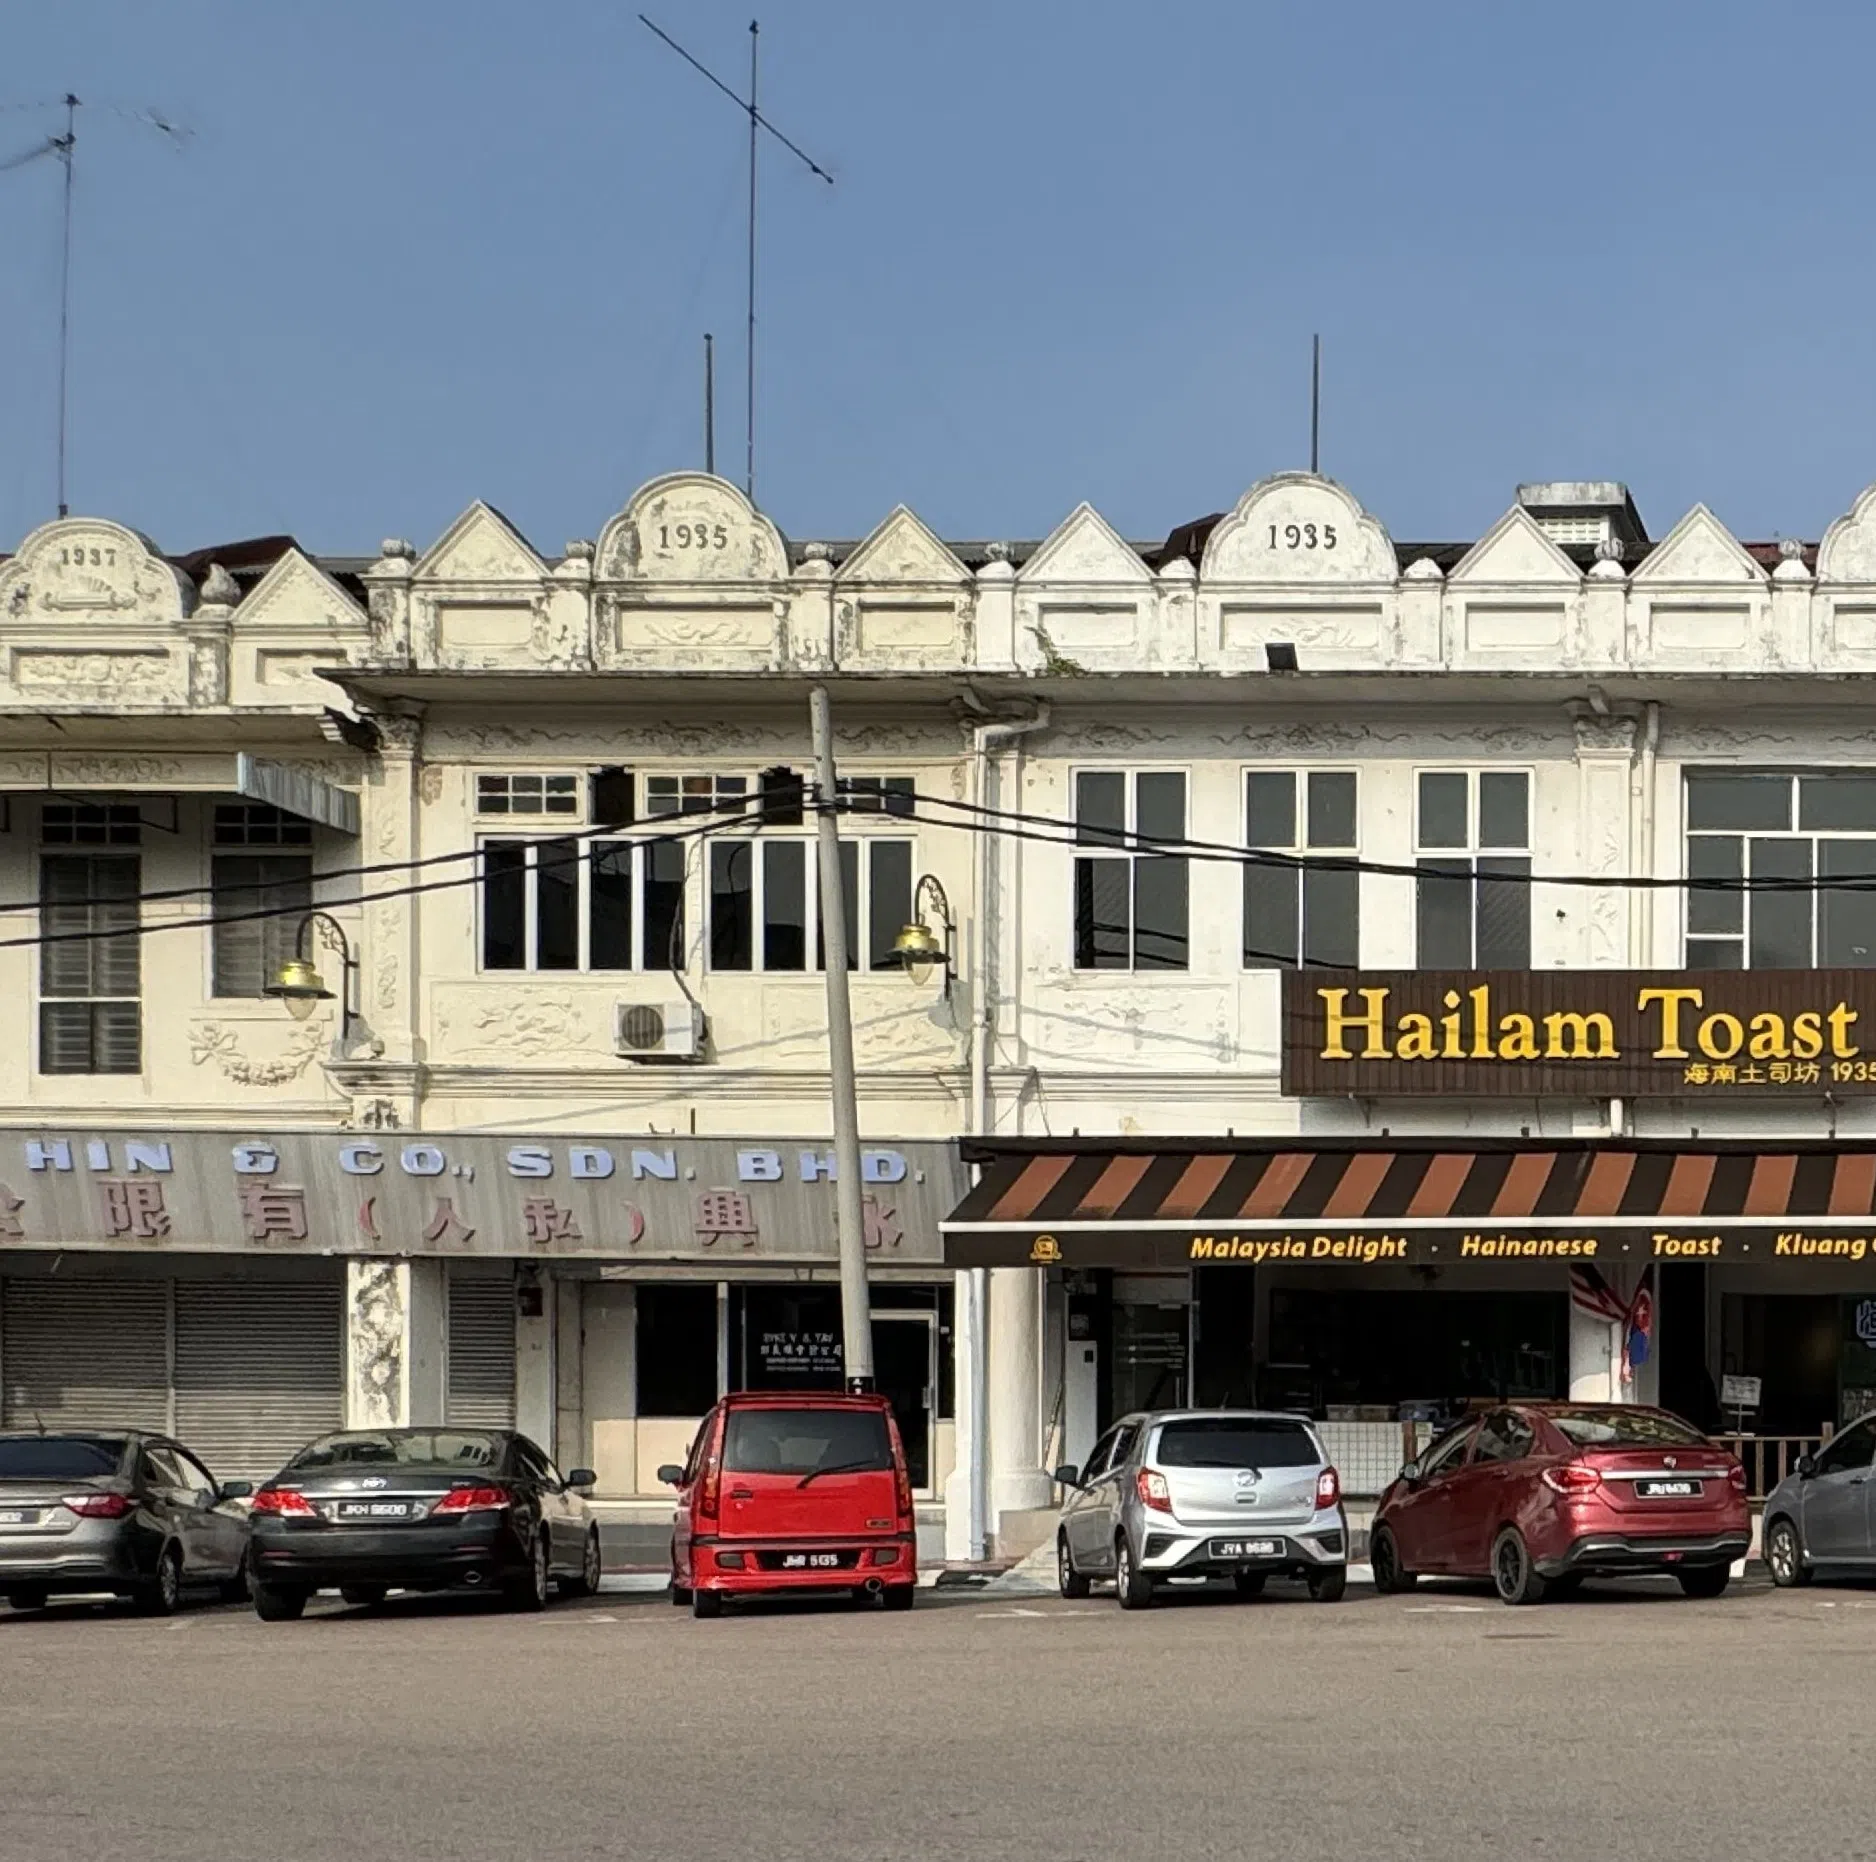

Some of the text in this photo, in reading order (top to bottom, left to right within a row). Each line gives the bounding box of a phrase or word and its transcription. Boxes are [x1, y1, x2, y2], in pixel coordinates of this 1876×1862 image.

[659, 524, 728, 549] 1935
[1268, 523, 1337, 549] 1935
[61, 549, 116, 565] 1937
[1317, 983, 1860, 1060] Hailam Toast
[1683, 1062, 1821, 1085] 海南土司坊
[25, 1139, 173, 1173] HIN
[232, 1140, 280, 1174] &
[507, 1145, 696, 1180] SDN.
[737, 1149, 925, 1183] BHD.
[1190, 1236, 1307, 1263] Malaysia
[1311, 1235, 1408, 1263] Delight
[1461, 1234, 1598, 1256] Hainanese
[1652, 1234, 1723, 1256] Toast
[1775, 1233, 1867, 1260] Kluang
